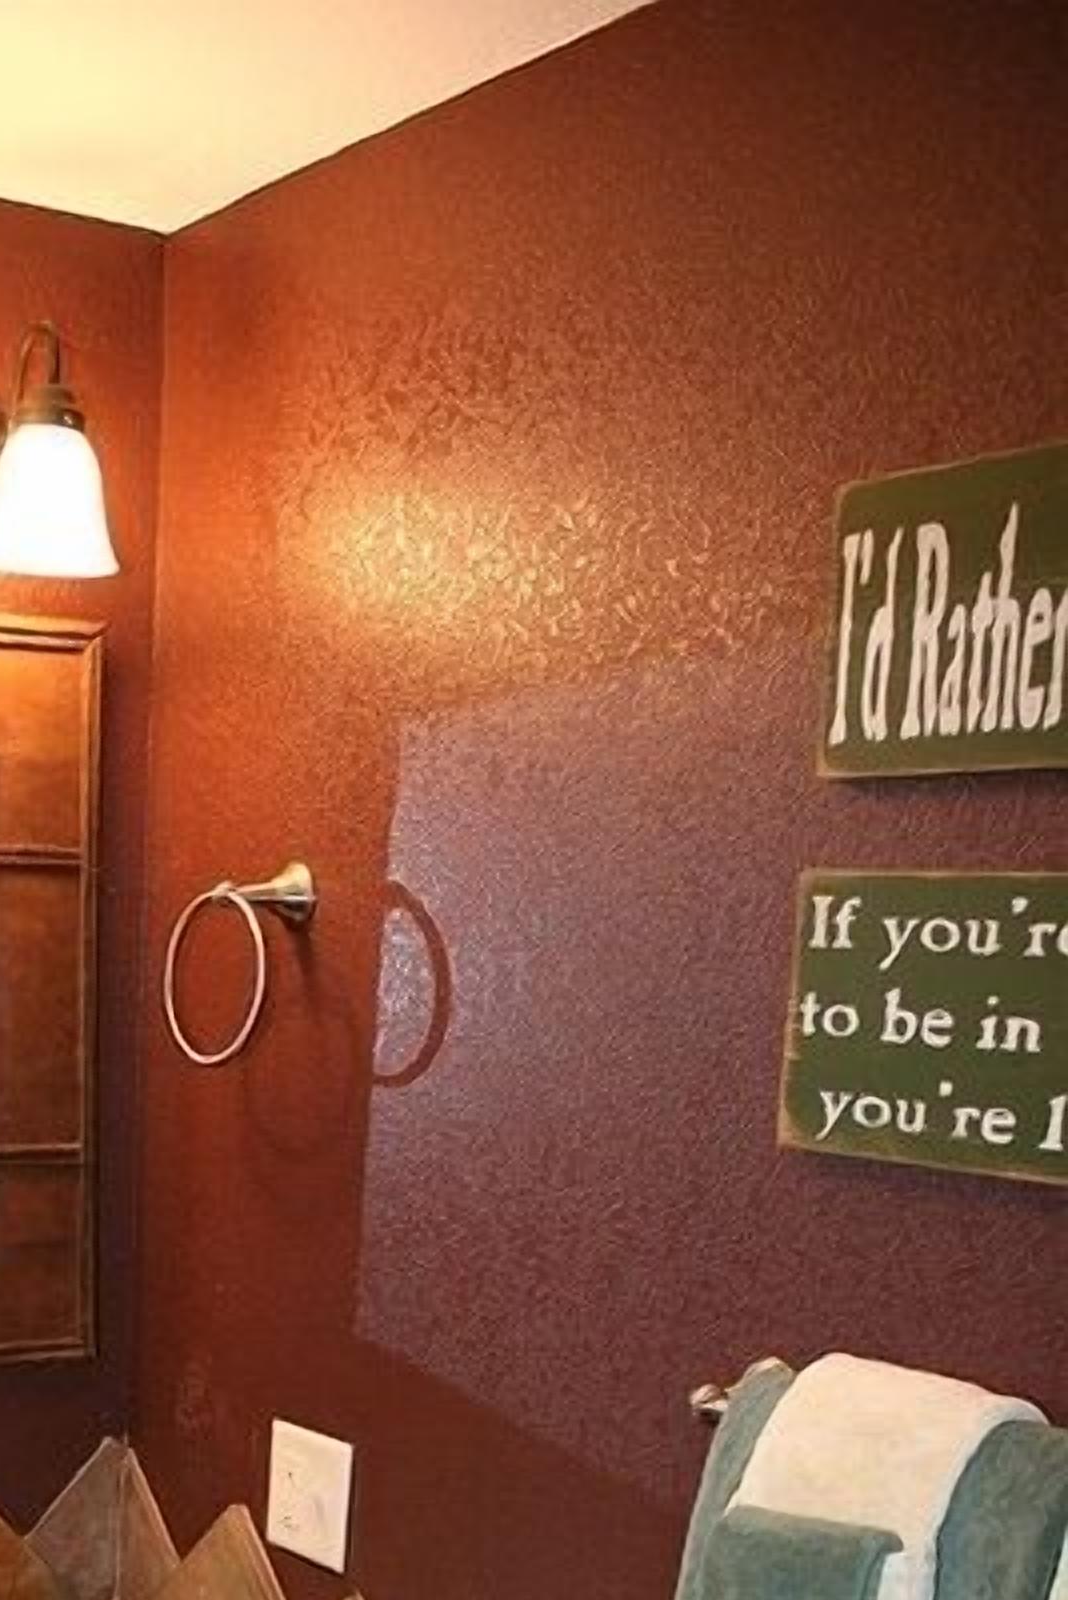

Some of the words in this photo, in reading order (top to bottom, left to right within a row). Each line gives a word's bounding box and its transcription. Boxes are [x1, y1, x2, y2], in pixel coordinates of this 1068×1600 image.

[829, 527, 904, 745] I'd
[810, 895, 862, 949] If
[800, 991, 860, 1036] to
[880, 987, 954, 1048] be
[975, 995, 1042, 1053] in
[815, 1081, 1017, 1145] you're
